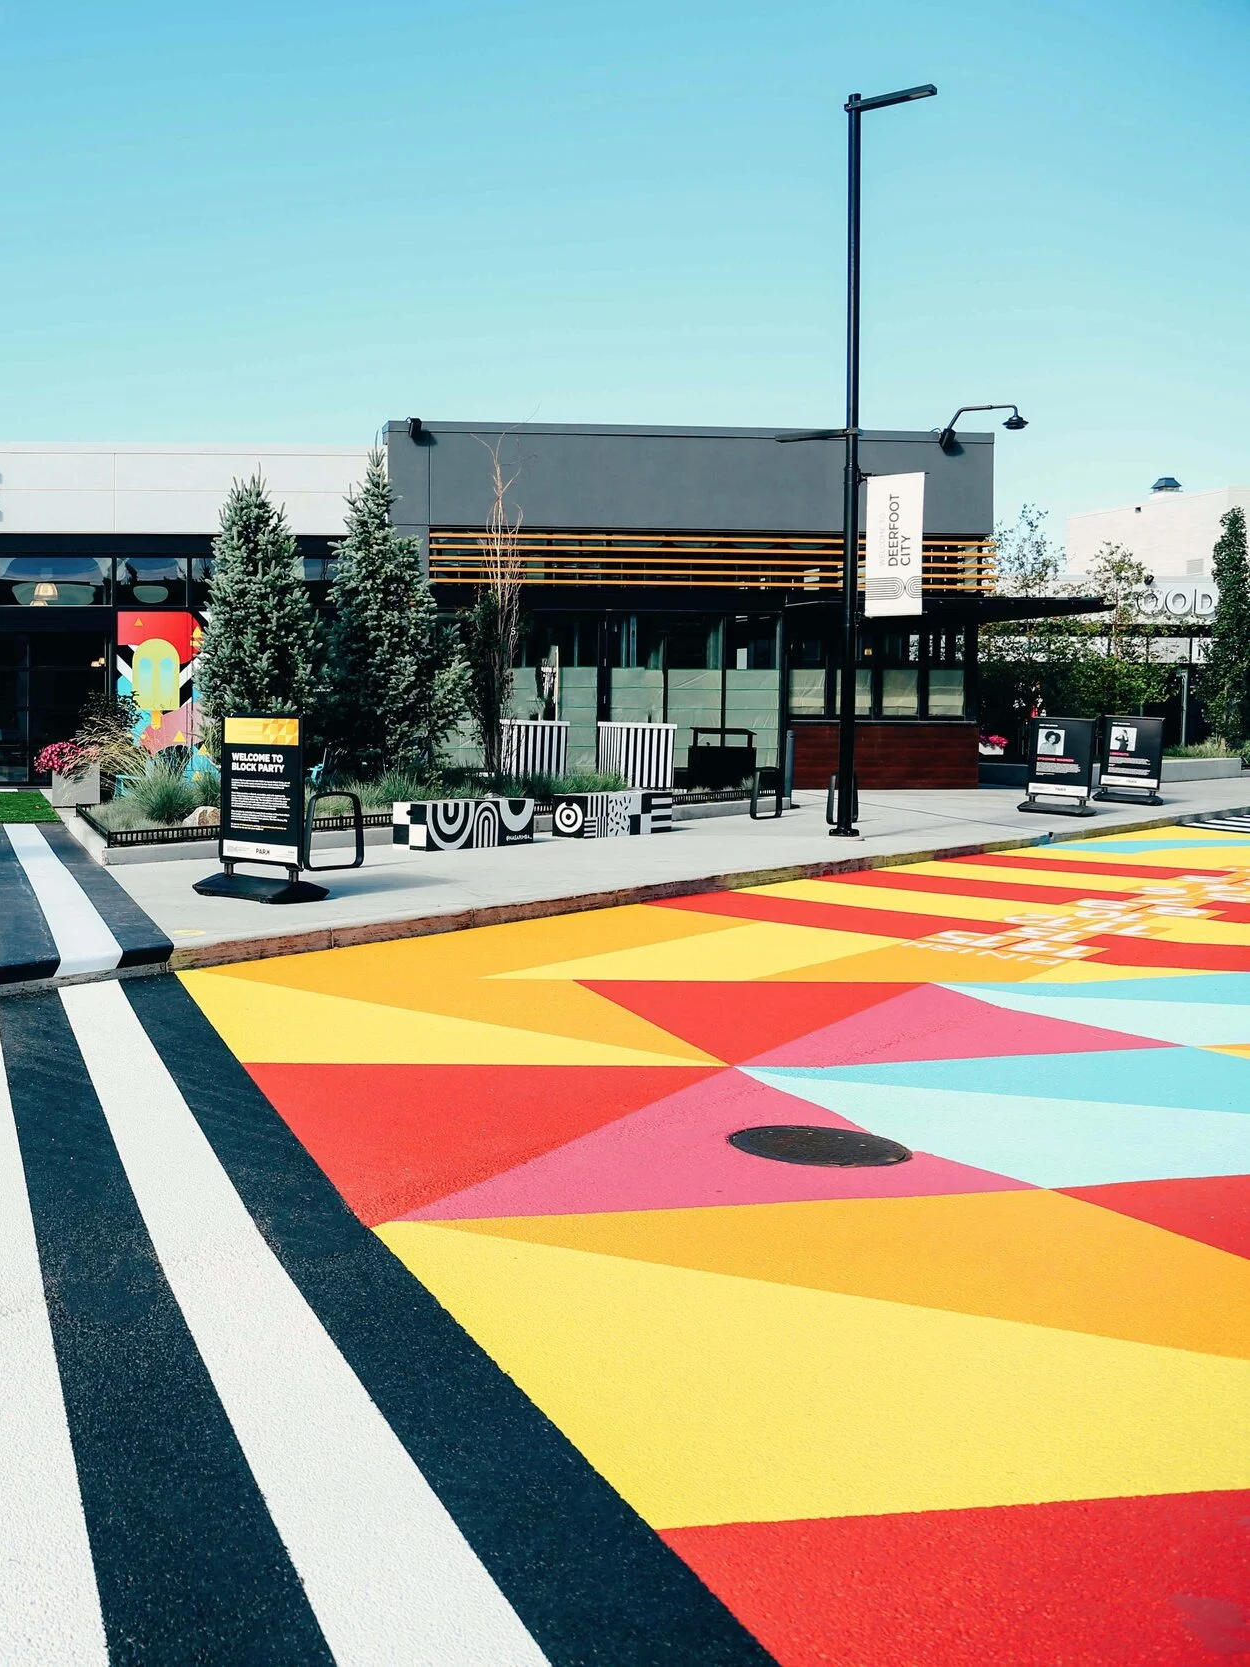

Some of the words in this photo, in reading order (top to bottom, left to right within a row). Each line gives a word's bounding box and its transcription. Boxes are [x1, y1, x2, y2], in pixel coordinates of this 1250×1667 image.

[879, 512, 887, 523] TO
[888, 494, 900, 567] DEERFOOT
[878, 525, 886, 567] WELCOME
[901, 535, 911, 566] CITY
[231, 752, 270, 763] WELCOME
[271, 753, 284, 763] TO
[231, 762, 257, 772] BLOCK
[258, 763, 285, 773] PARTY
[1003, 912, 1077, 928] 12
[1074, 909, 1144, 922] 10
[999, 927, 1083, 943] 13
[1082, 920, 1149, 936] 11
[925, 929, 1006, 947] 15
[901, 940, 1066, 966] FINISH
[1010, 939, 1091, 958] 14
